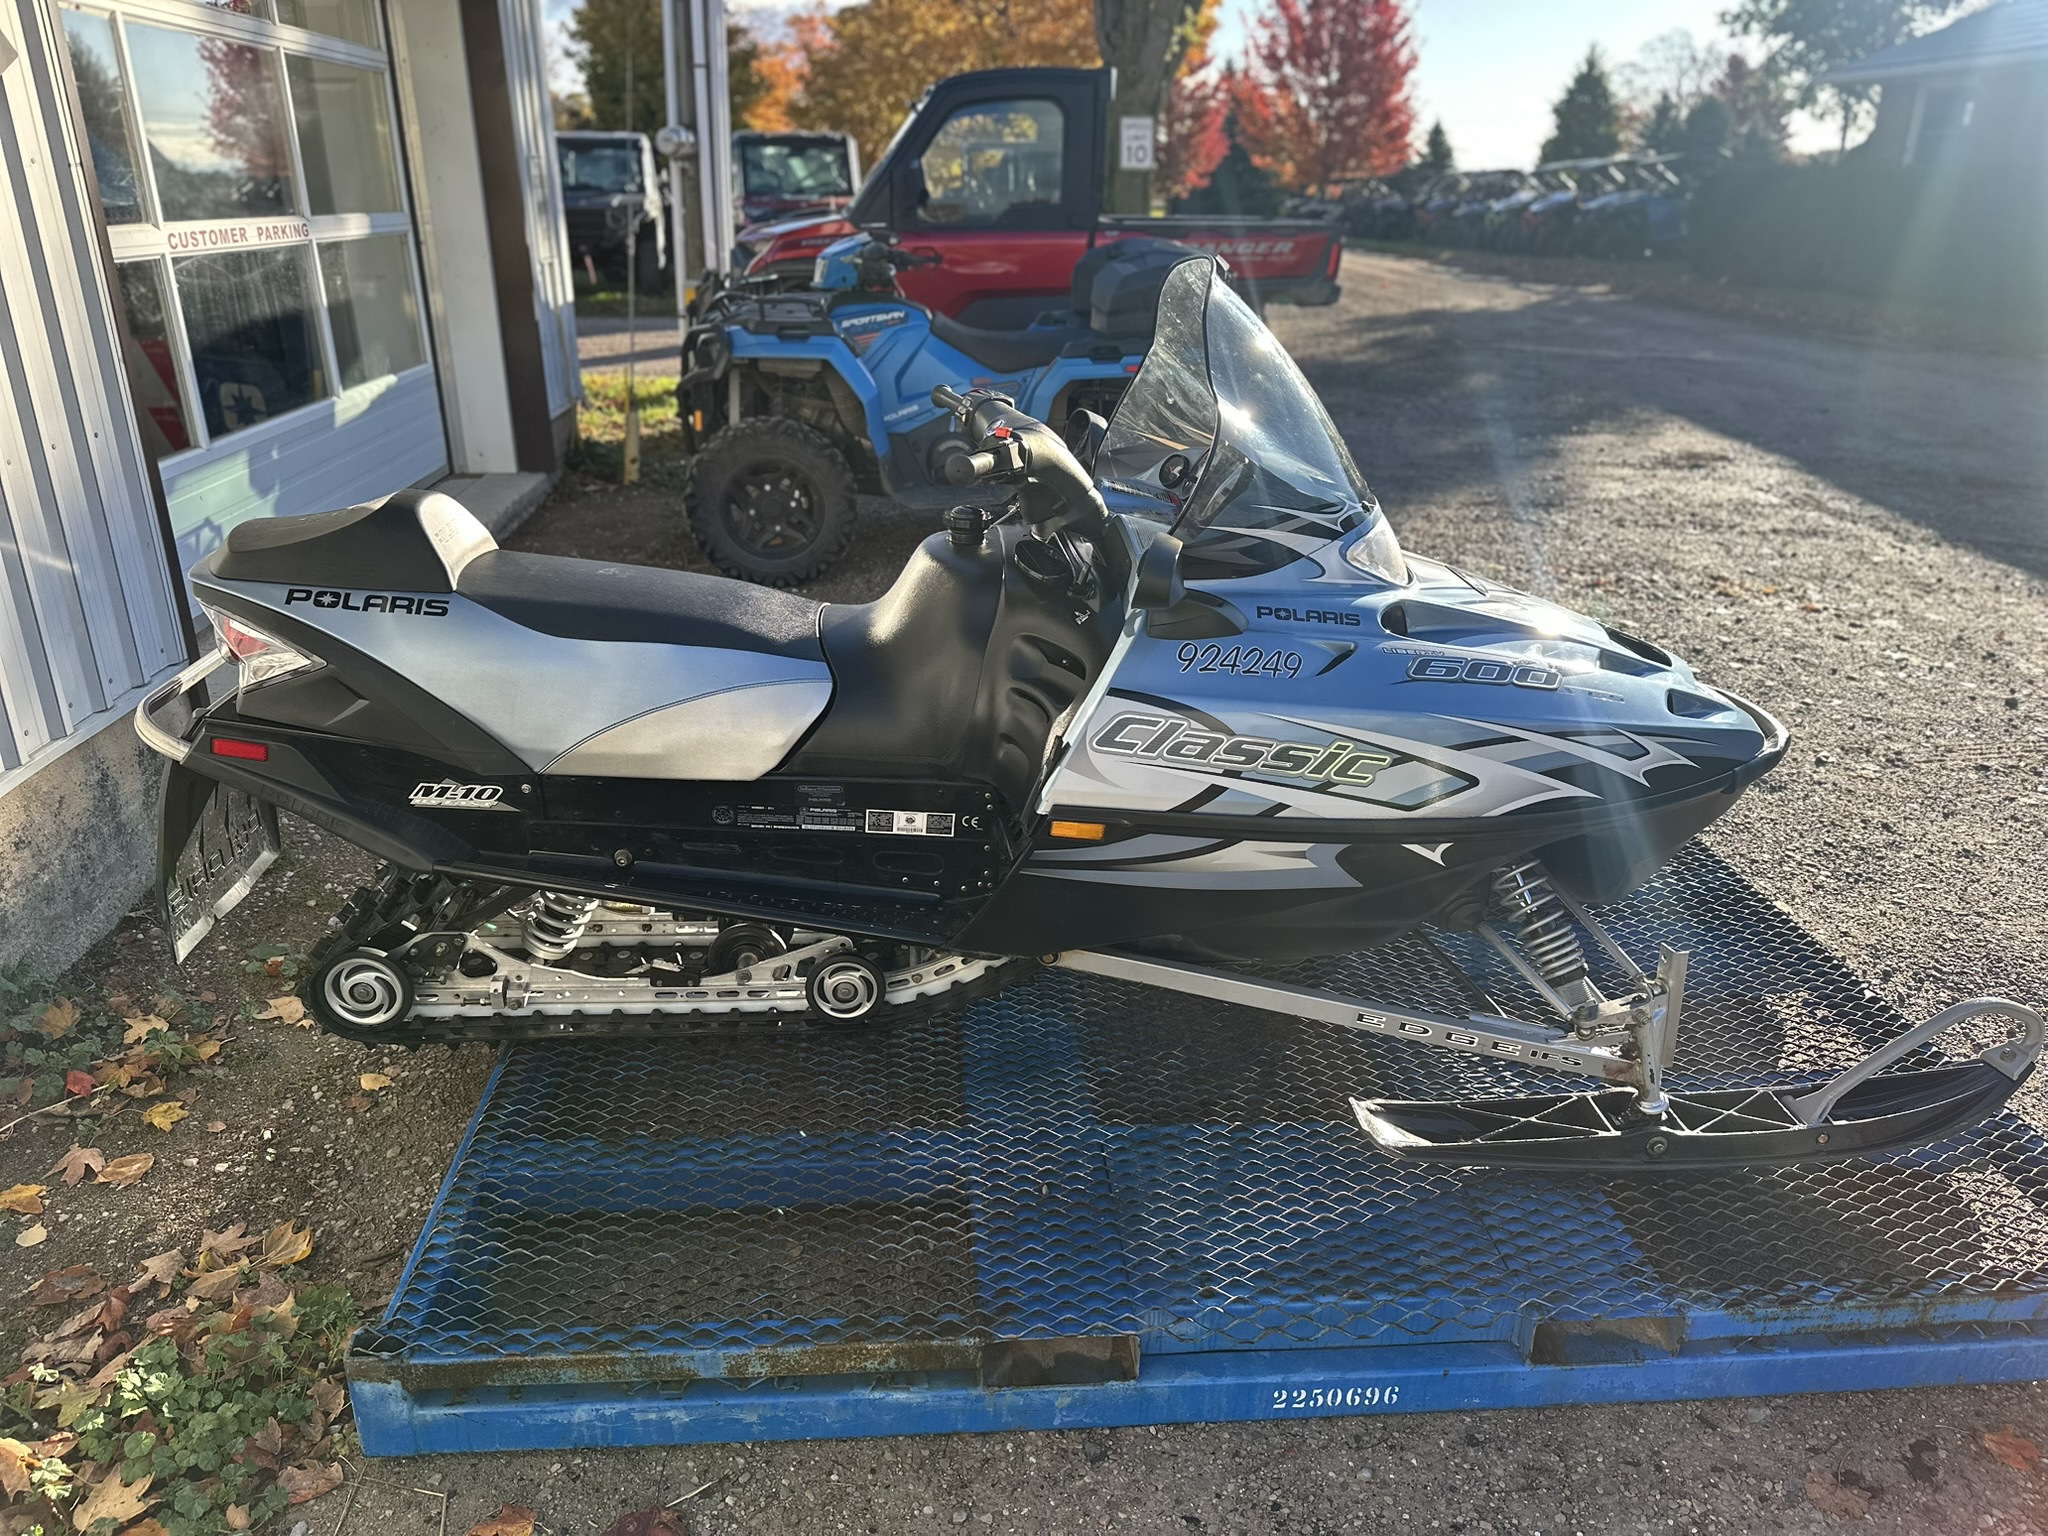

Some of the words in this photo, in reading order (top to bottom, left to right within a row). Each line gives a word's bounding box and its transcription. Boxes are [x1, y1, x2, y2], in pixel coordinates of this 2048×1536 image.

[1127, 144, 1149, 163] 10
[167, 227, 249, 250] CUSTOMER
[256, 223, 310, 242] PARKING
[841, 311, 905, 328] SPORTSMAN
[284, 588, 450, 617] POLARIS
[1256, 605, 1361, 627] POLARIS
[1177, 641, 1304, 680] 924249
[1406, 656, 1564, 691] 600
[1089, 712, 1393, 786] Classic
[408, 782, 504, 801] M-10
[961, 815, 979, 828] CE
[1356, 1011, 1522, 1057] EDGE
[1529, 1049, 1583, 1068] IFS
[1272, 1386, 1399, 1409] 2250696
